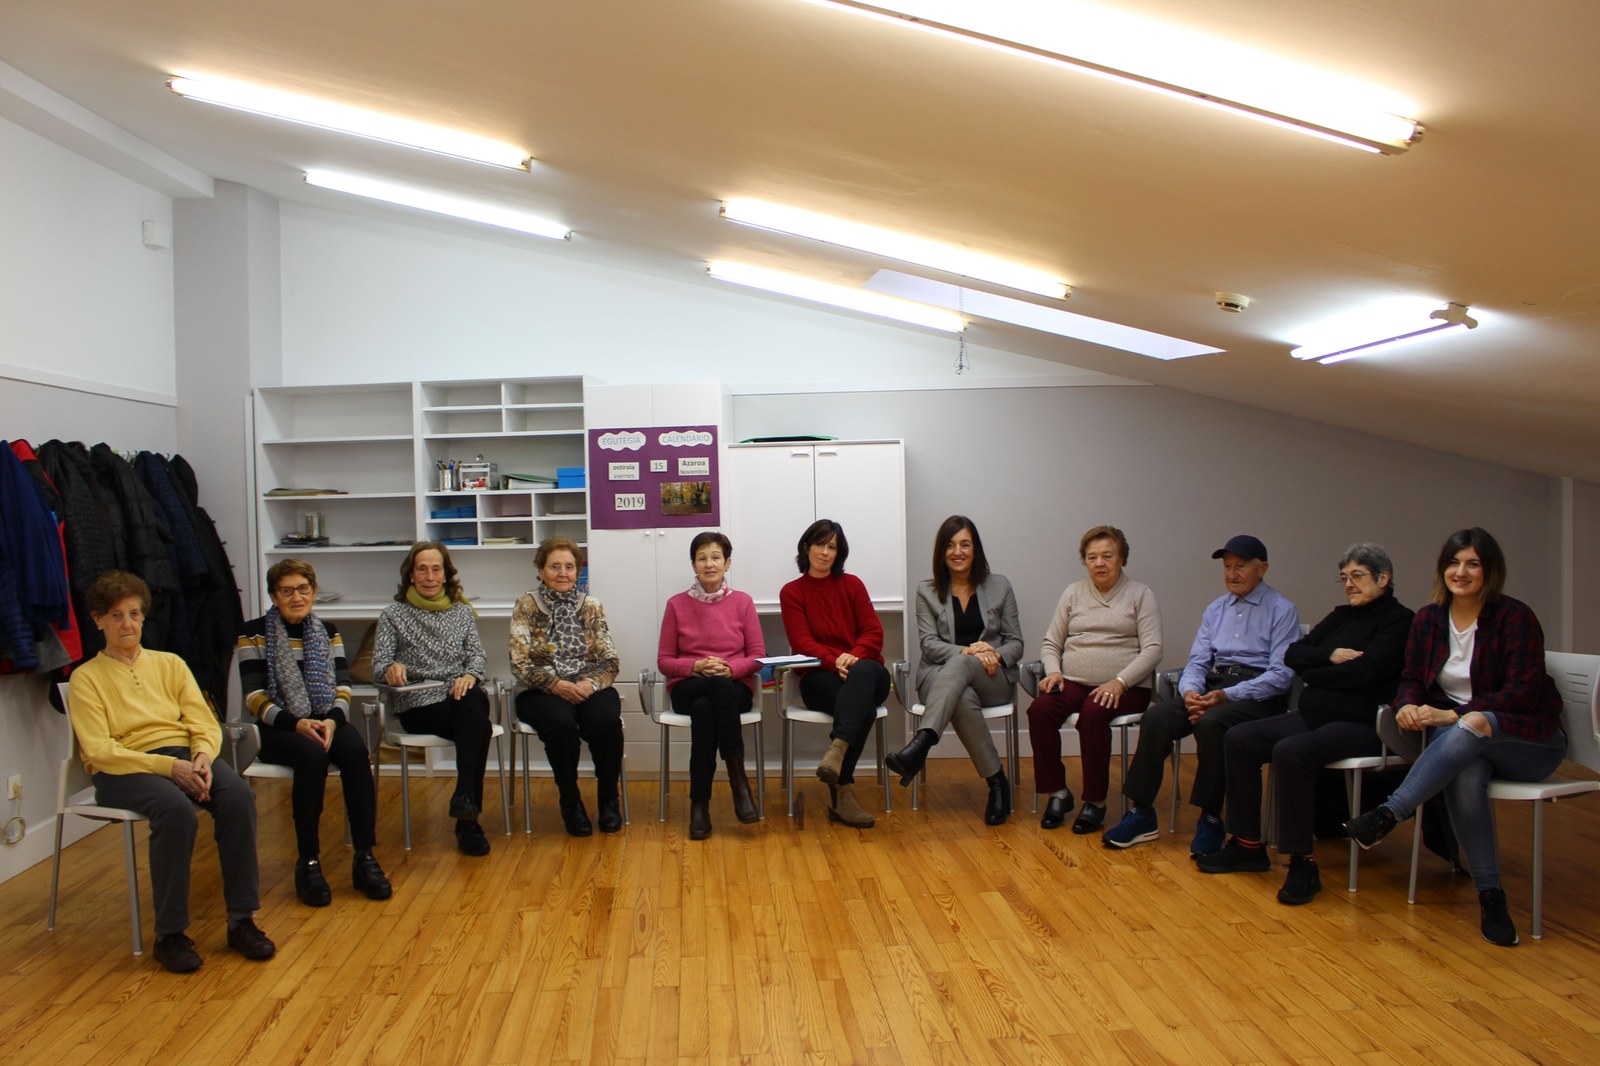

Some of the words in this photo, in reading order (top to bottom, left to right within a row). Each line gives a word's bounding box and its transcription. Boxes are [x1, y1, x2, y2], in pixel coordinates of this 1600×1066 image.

[602, 436, 642, 446] EGUTEGIA
[662, 434, 710, 444] CALENDARIO
[616, 496, 644, 508] 2019
